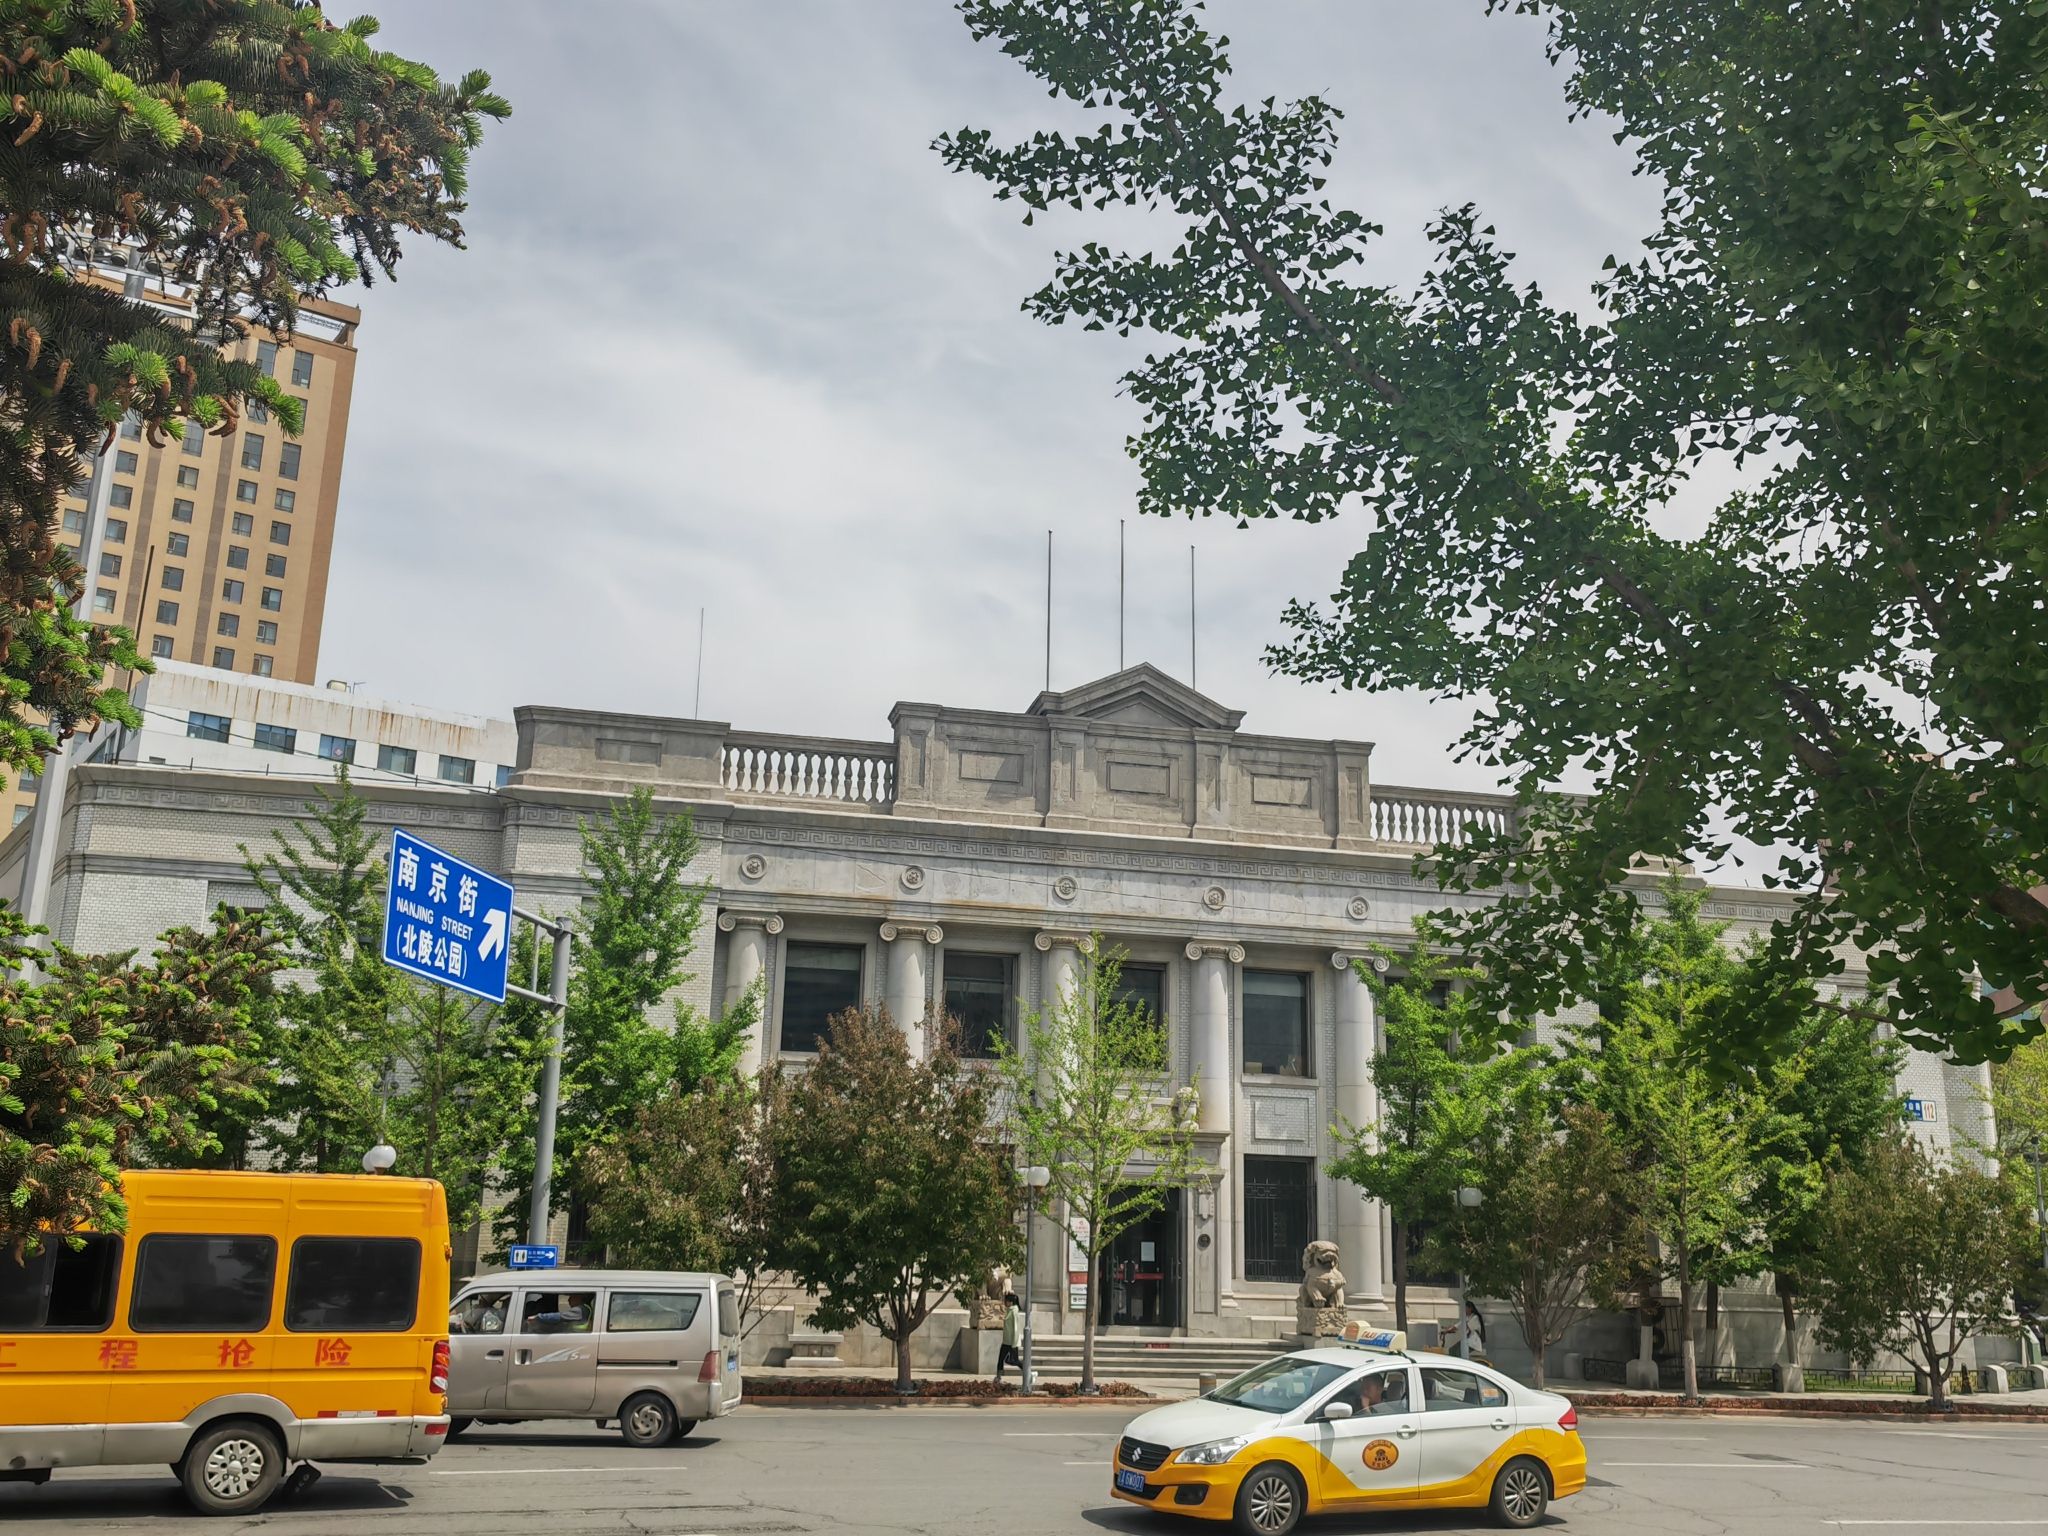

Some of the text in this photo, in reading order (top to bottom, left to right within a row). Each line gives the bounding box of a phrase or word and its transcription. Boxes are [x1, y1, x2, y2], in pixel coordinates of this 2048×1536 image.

[397, 847, 479, 918] 南京街
[396, 896, 474, 940] NANJING STREET
